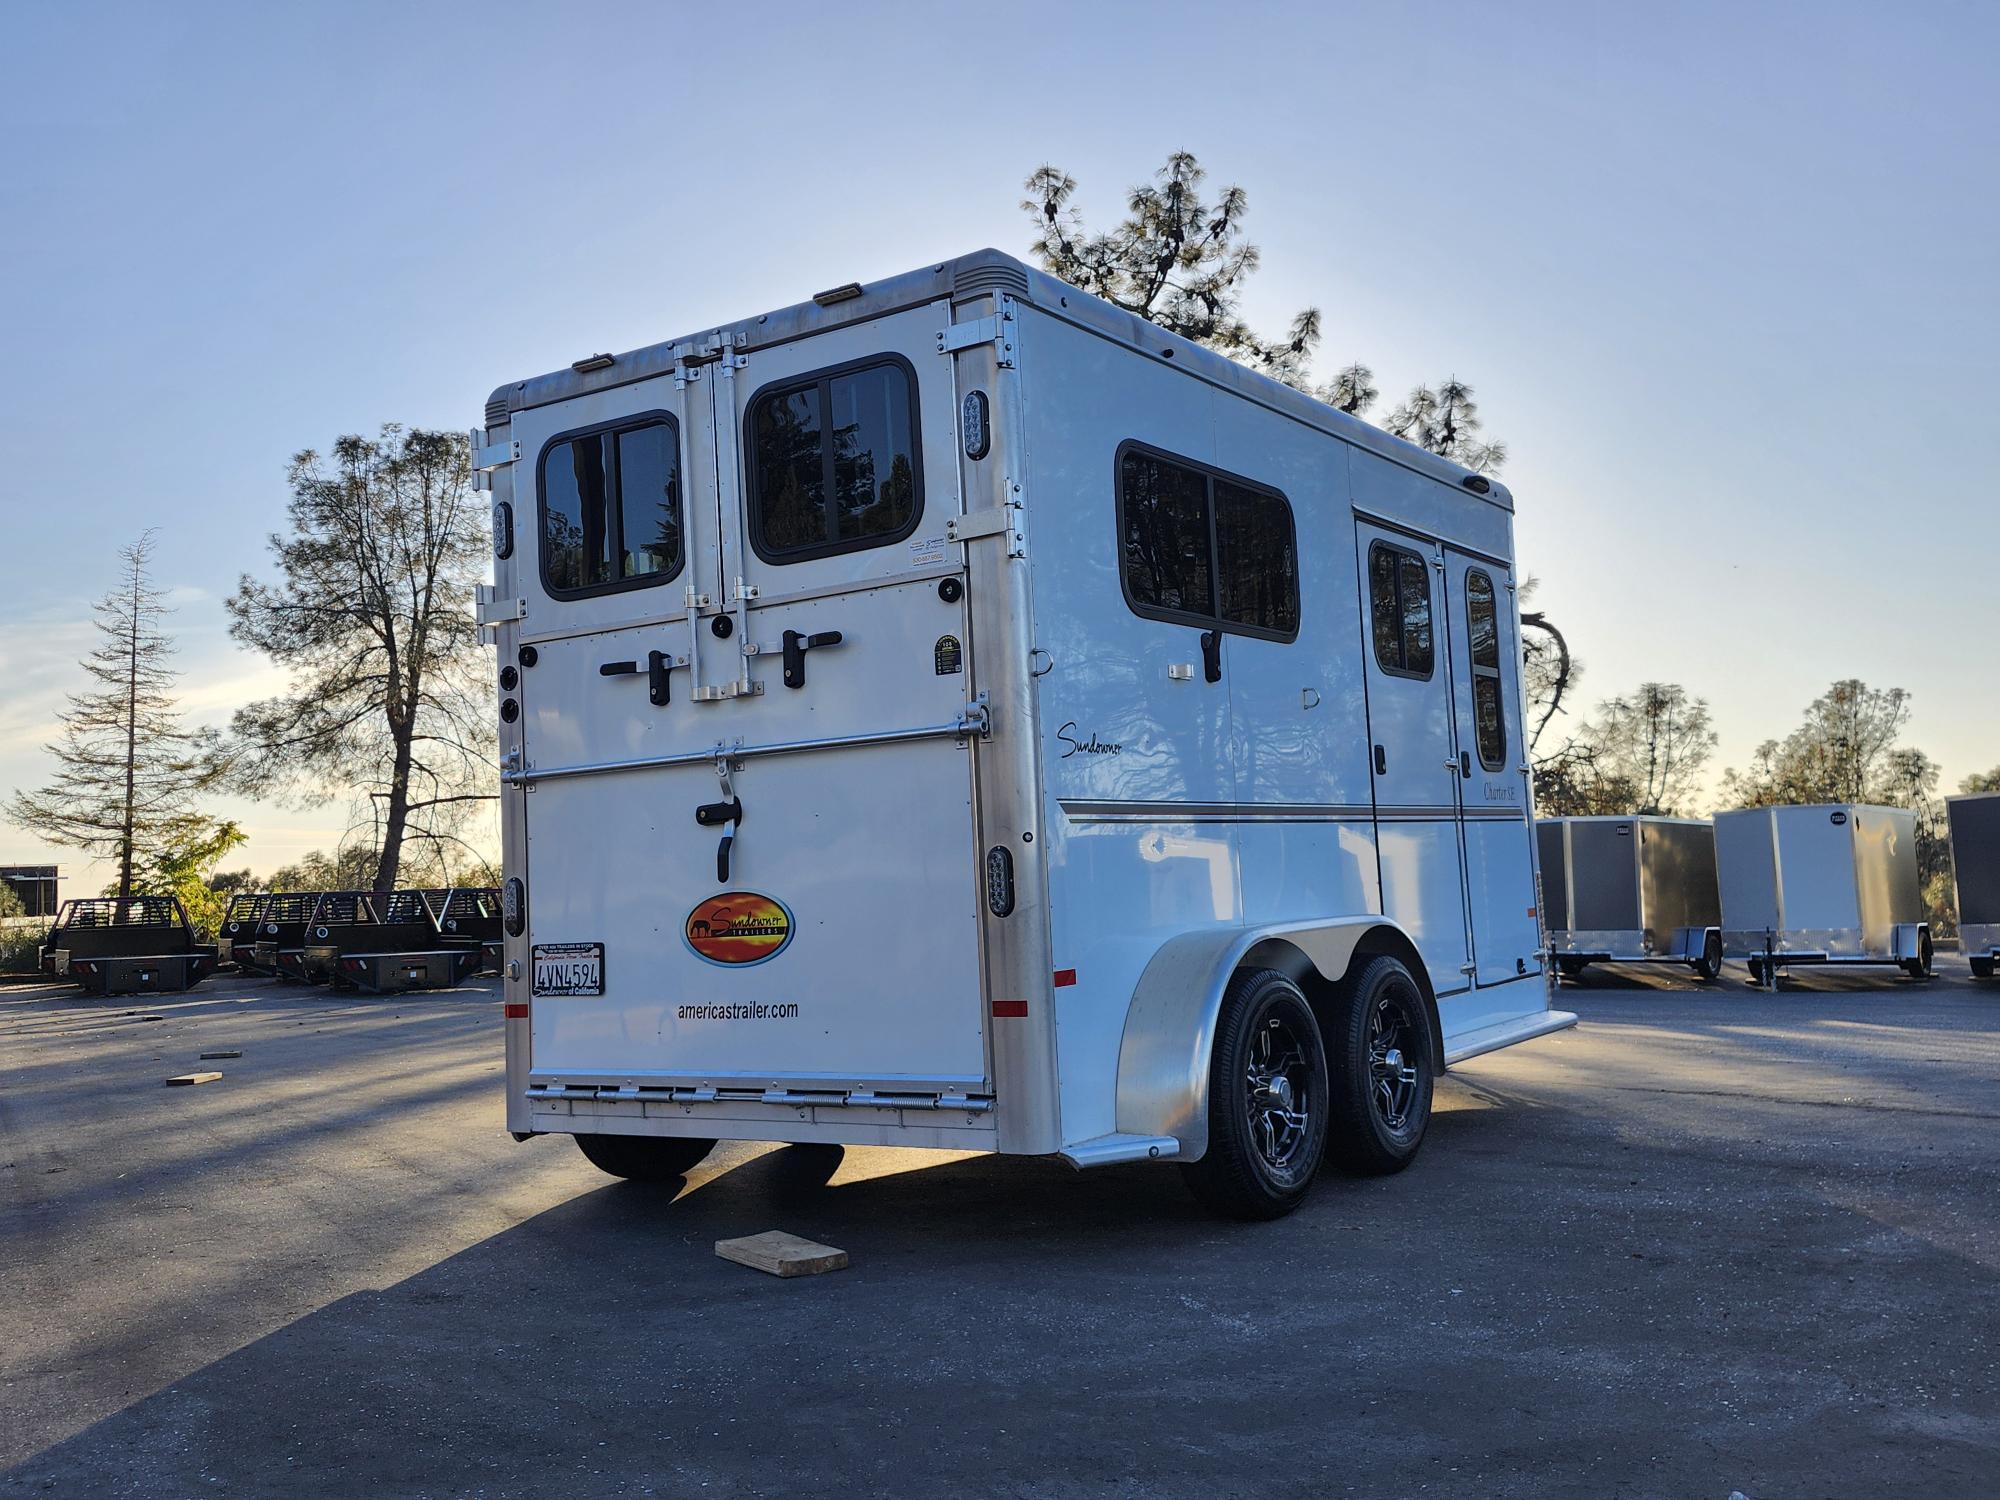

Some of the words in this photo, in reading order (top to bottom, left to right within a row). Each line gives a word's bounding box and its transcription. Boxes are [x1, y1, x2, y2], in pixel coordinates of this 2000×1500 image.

[1057, 721, 1122, 759] Sundowner
[711, 906, 782, 935] Sundowner
[732, 928, 778, 936] TRAILERS
[537, 963, 598, 987] 4VN4594
[574, 986, 600, 995] California
[678, 1000, 799, 1020] americastrailer.com
